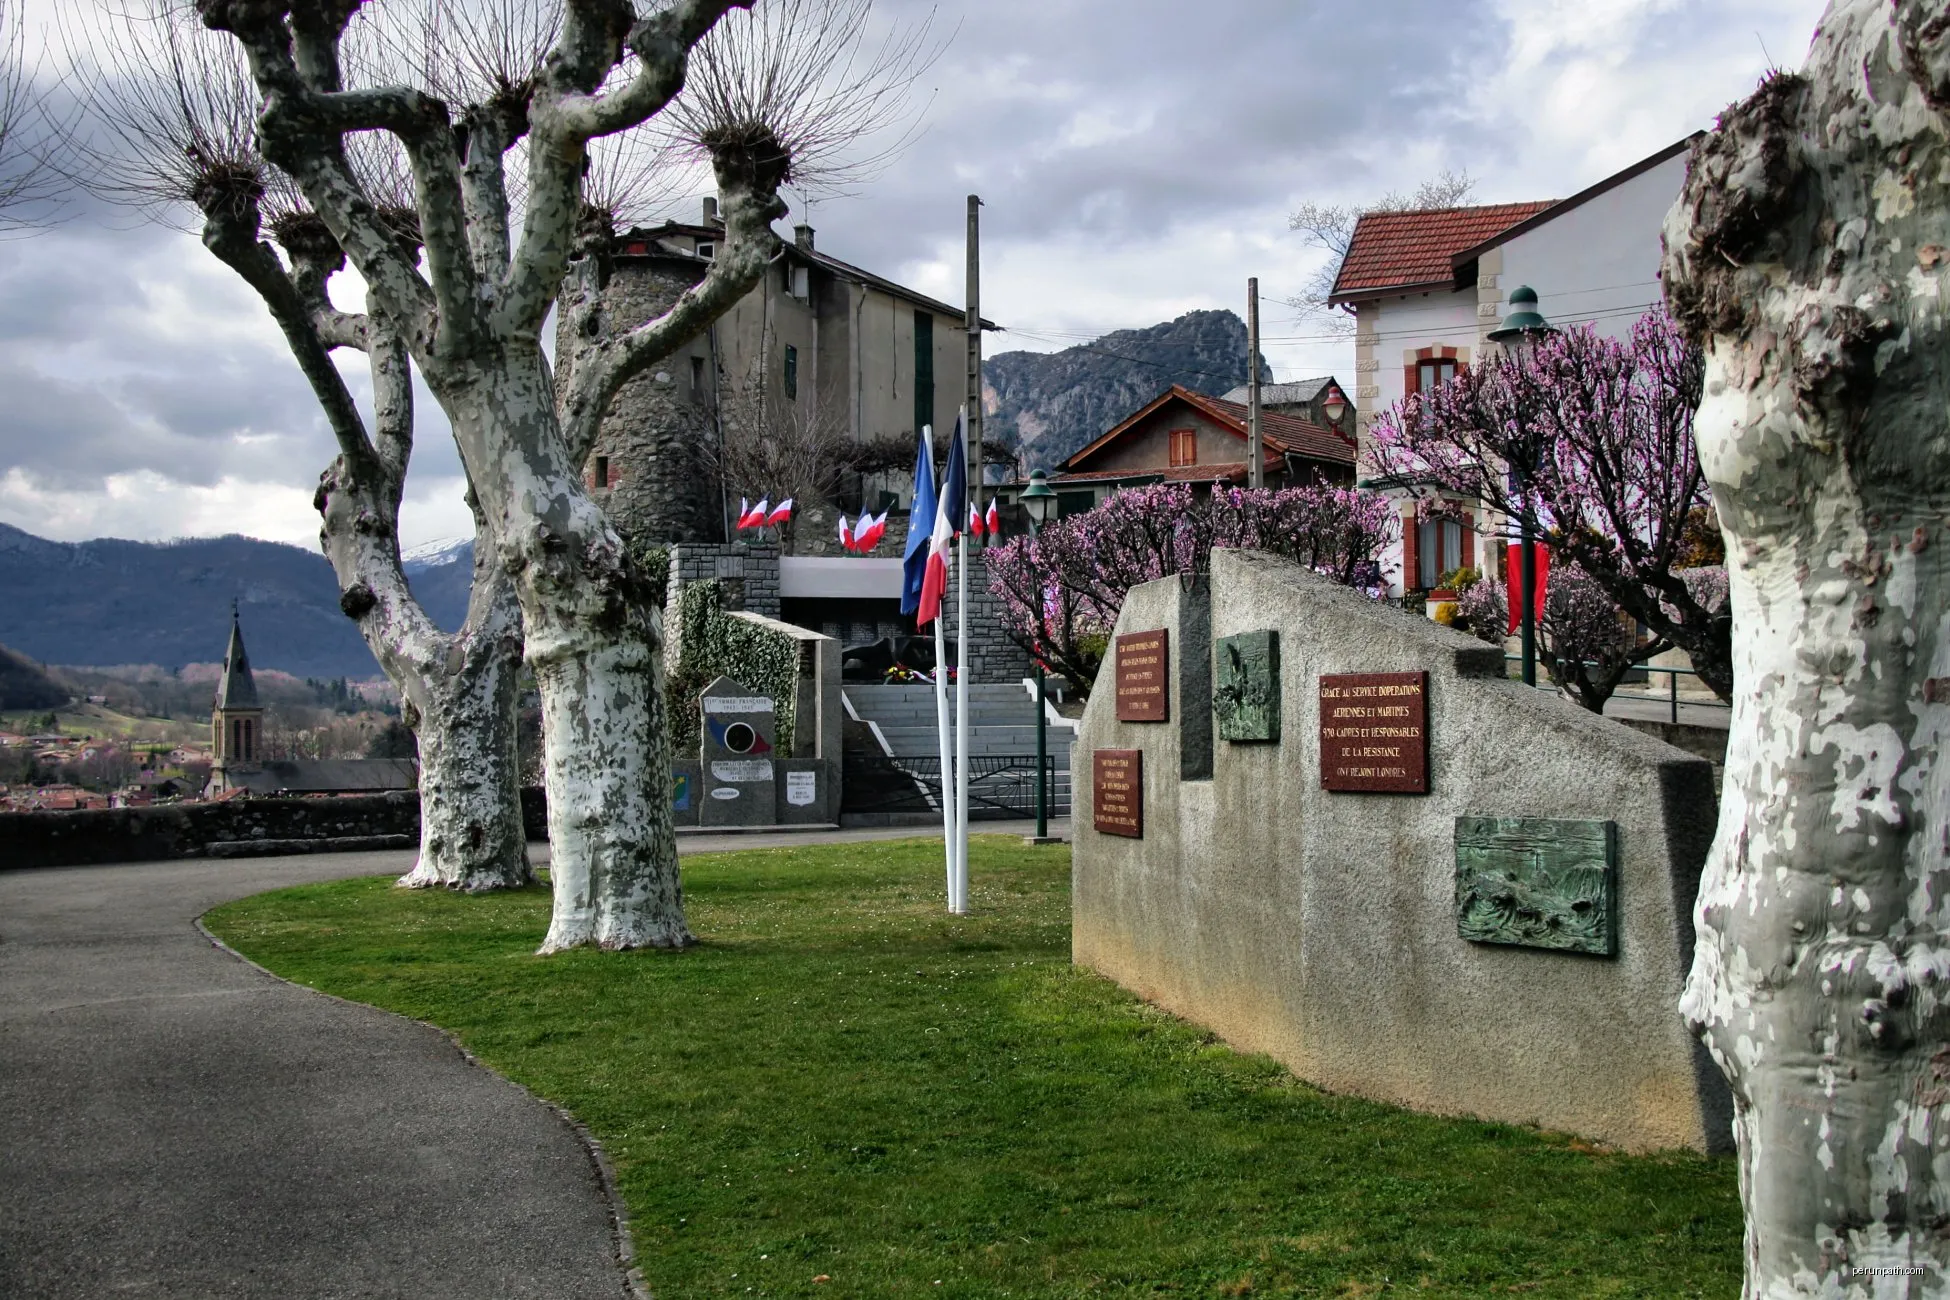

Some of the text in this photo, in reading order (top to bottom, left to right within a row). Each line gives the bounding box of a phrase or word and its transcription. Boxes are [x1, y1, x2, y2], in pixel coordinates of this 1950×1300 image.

[716, 557, 742, 577] 1914
[1321, 687, 1340, 698] GRACE
[1342, 688, 1350, 697] AU
[1352, 686, 1377, 697] SERVICE
[1333, 706, 1410, 718] AERIENNES ET MARITIMES
[1336, 727, 1360, 738] CADRES
[1361, 728, 1370, 737] ET
[1371, 727, 1420, 738] RESPONSABLES
[1342, 747, 1401, 757] DE LA RESISTANCE
[1337, 767, 1406, 778] ONT REJOINT LONDRES
